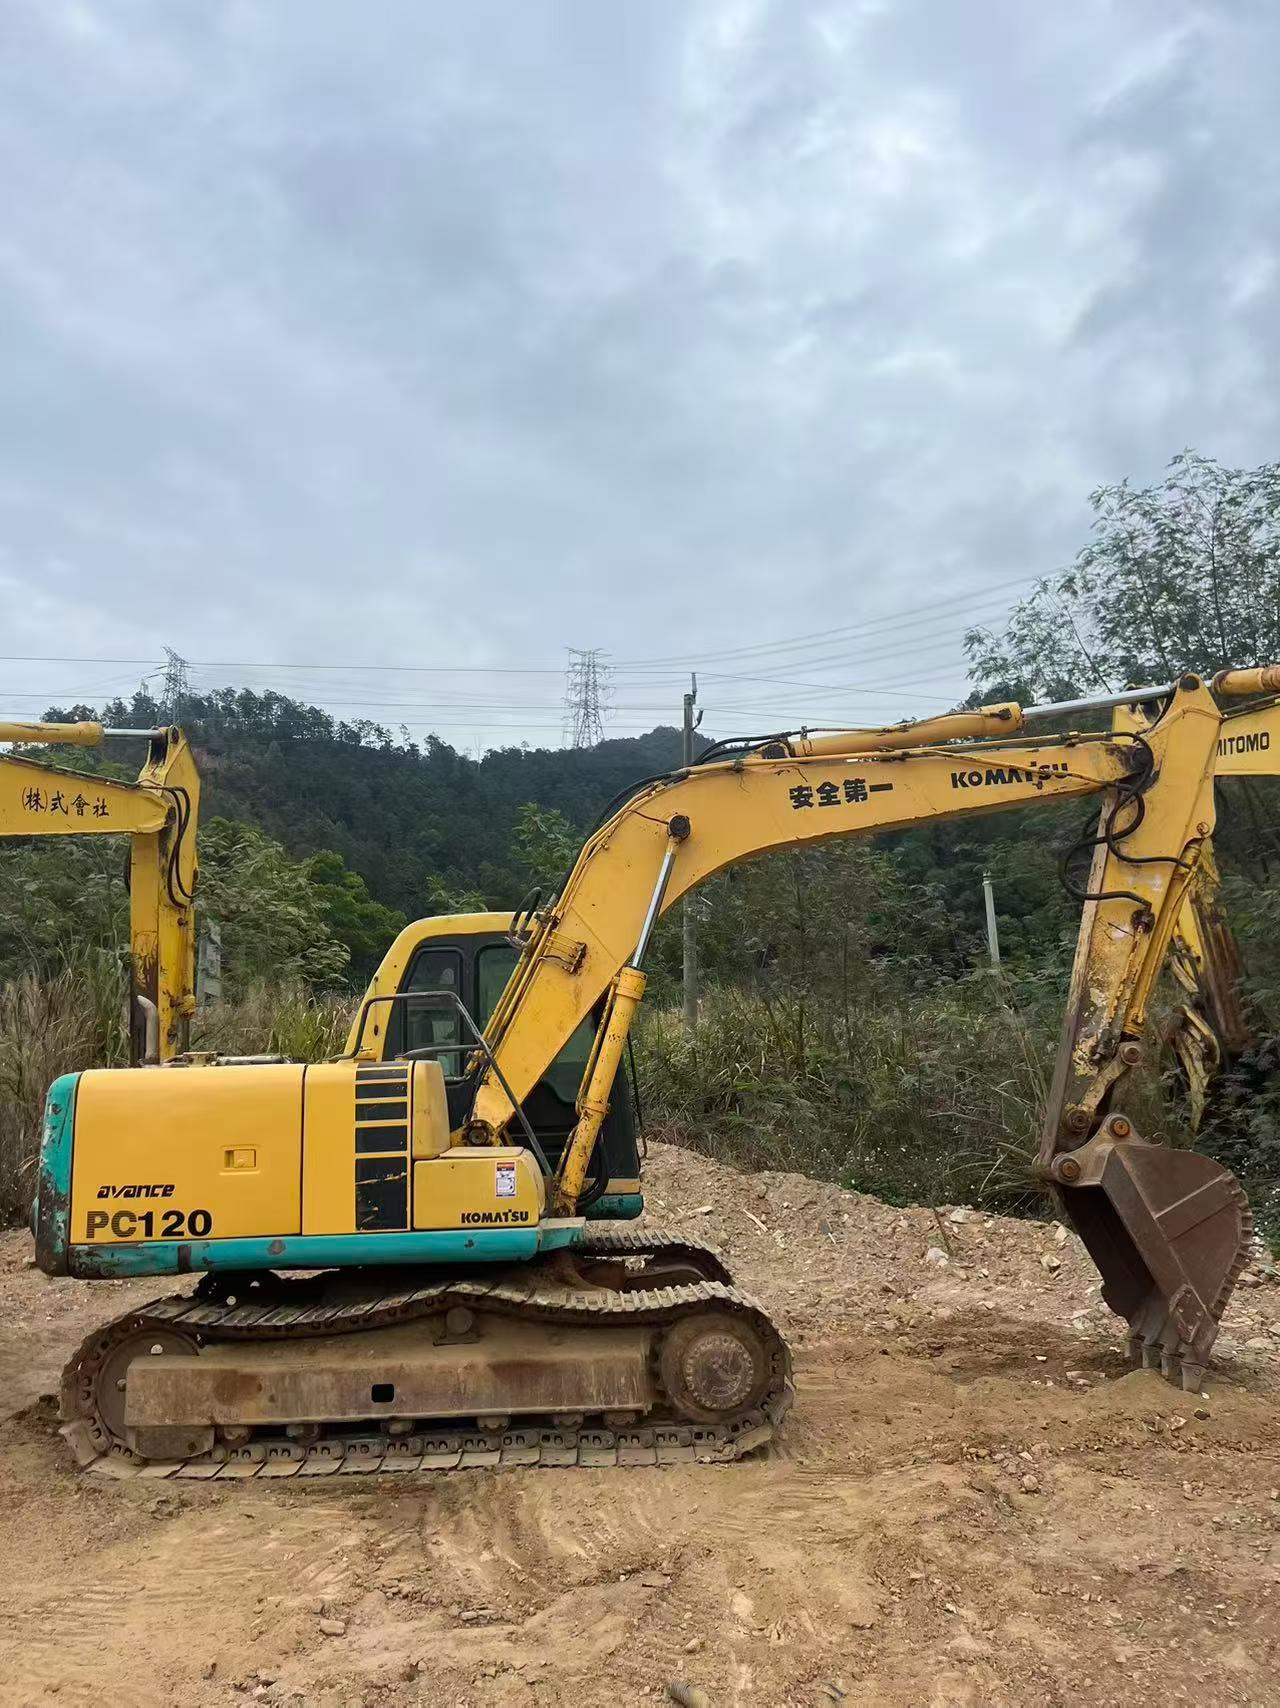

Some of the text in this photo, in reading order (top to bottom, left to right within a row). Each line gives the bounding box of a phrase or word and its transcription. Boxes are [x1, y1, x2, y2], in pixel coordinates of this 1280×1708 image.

[789, 778, 893, 810] 安全第一
[97, 1184, 175, 1199] avance
[86, 1209, 212, 1239] PC120
[461, 1209, 529, 1223] KOMATSU
